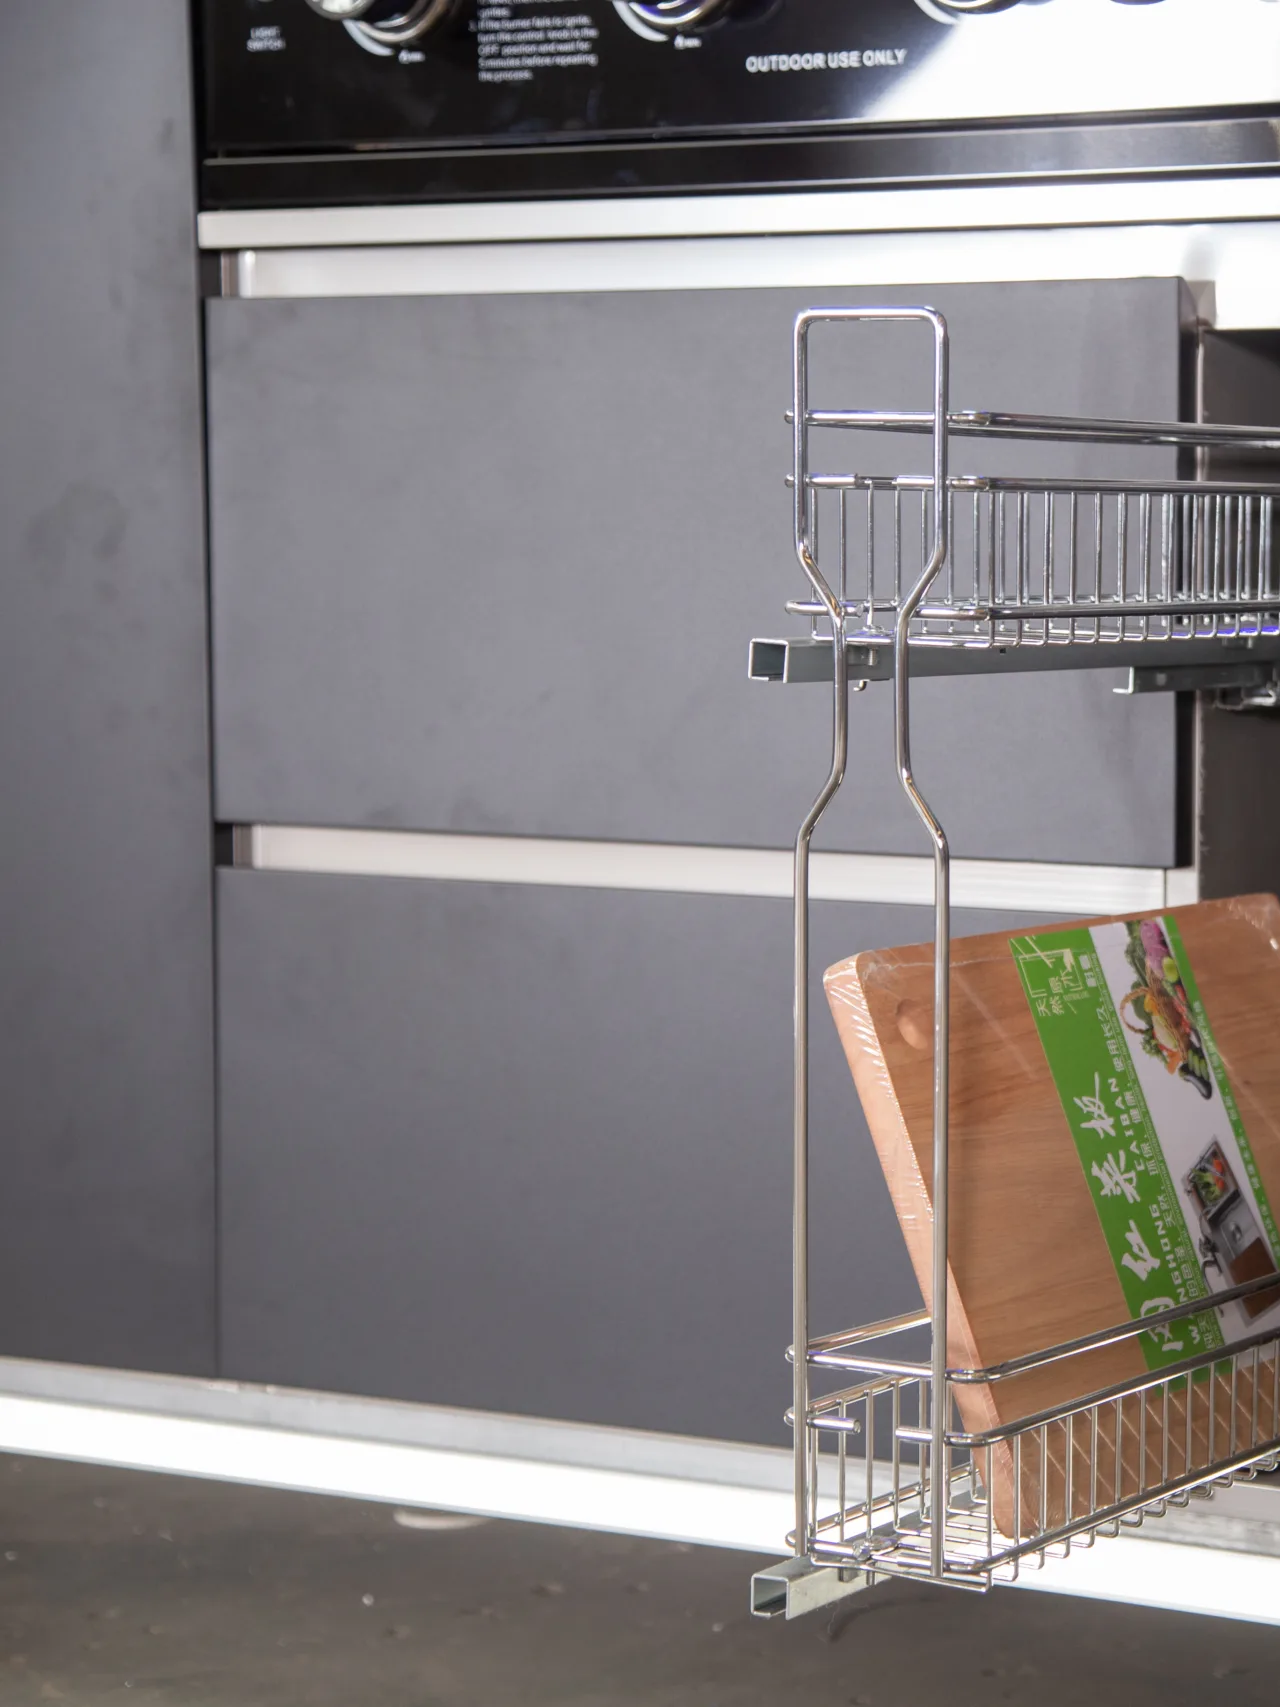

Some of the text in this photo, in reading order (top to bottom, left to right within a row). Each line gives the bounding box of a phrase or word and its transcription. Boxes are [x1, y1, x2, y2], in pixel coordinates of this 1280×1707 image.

[745, 48, 907, 73] OUTDOOR USE ONLY
[1076, 1076, 1181, 1349] 网红菜板
[1106, 1075, 1202, 1345] WNGHONG CAIBAN
